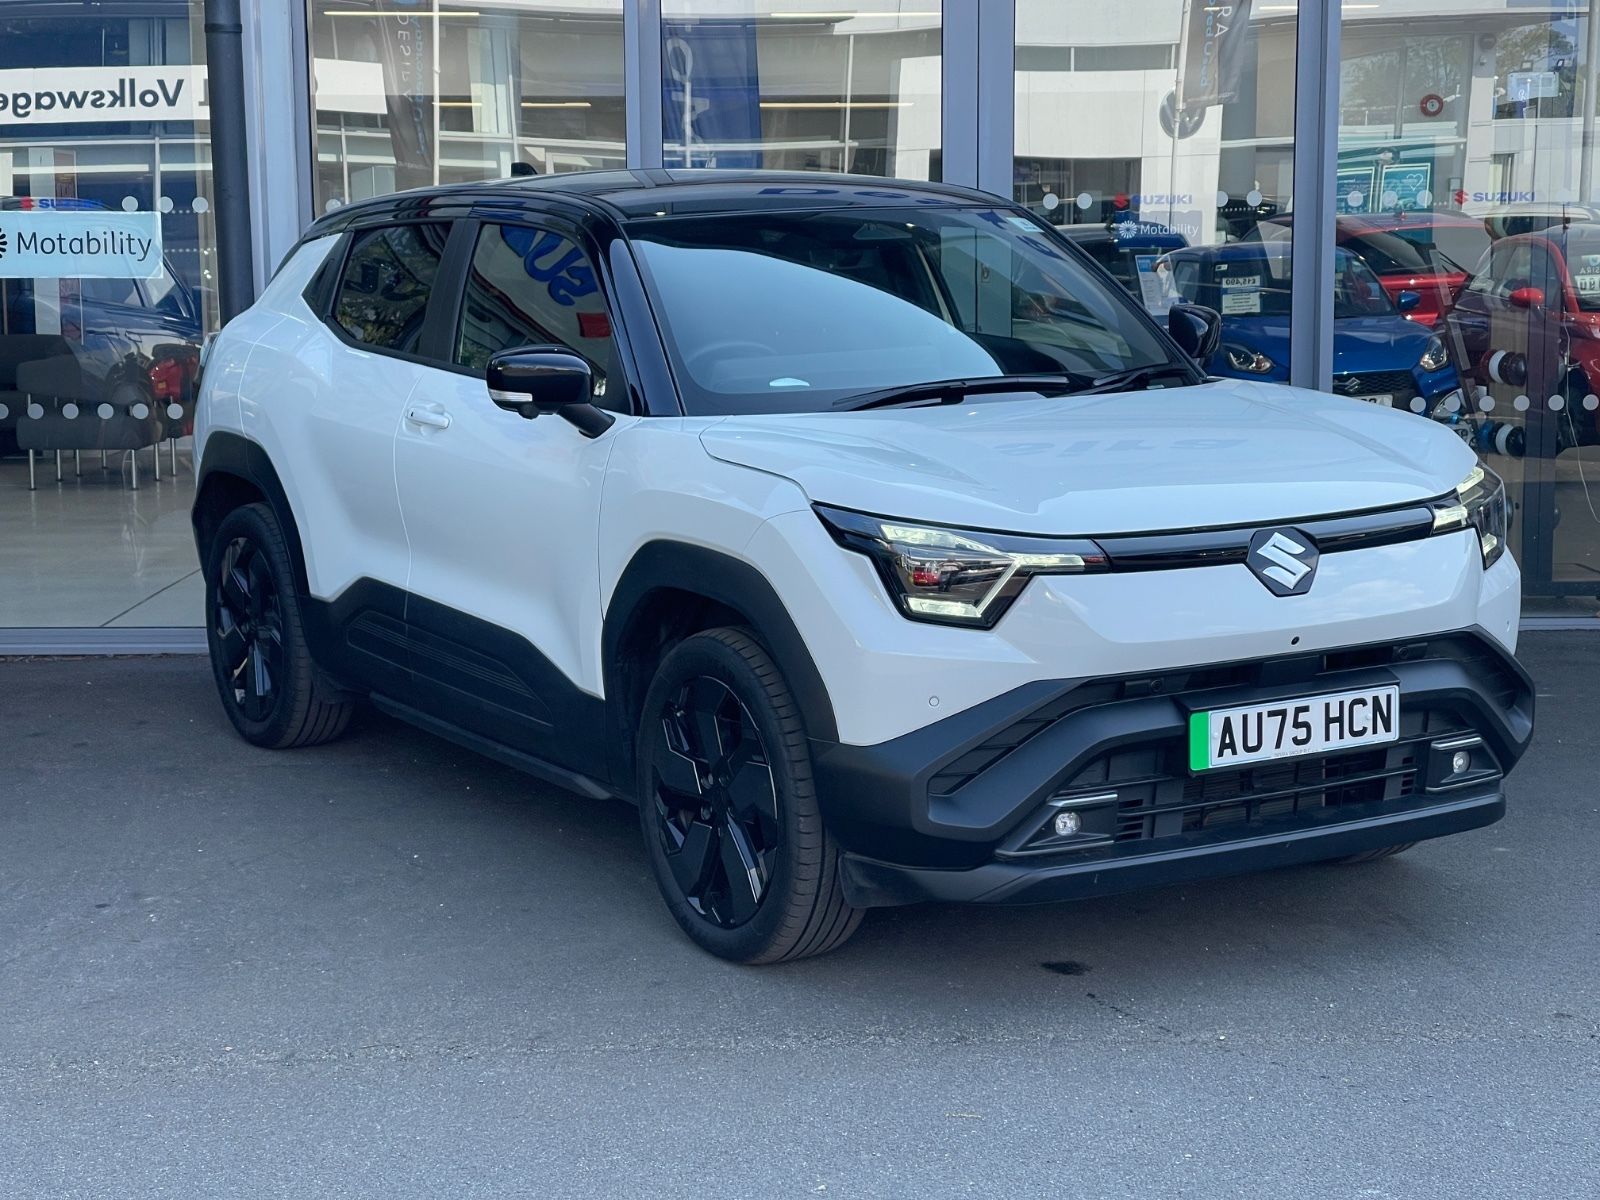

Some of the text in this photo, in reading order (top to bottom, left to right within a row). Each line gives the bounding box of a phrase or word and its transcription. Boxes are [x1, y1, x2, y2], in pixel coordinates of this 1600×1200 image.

[1472, 191, 1535, 202] SUZUKI
[17, 231, 153, 262] Motability
[1217, 693, 1392, 758] AU75 HCN
